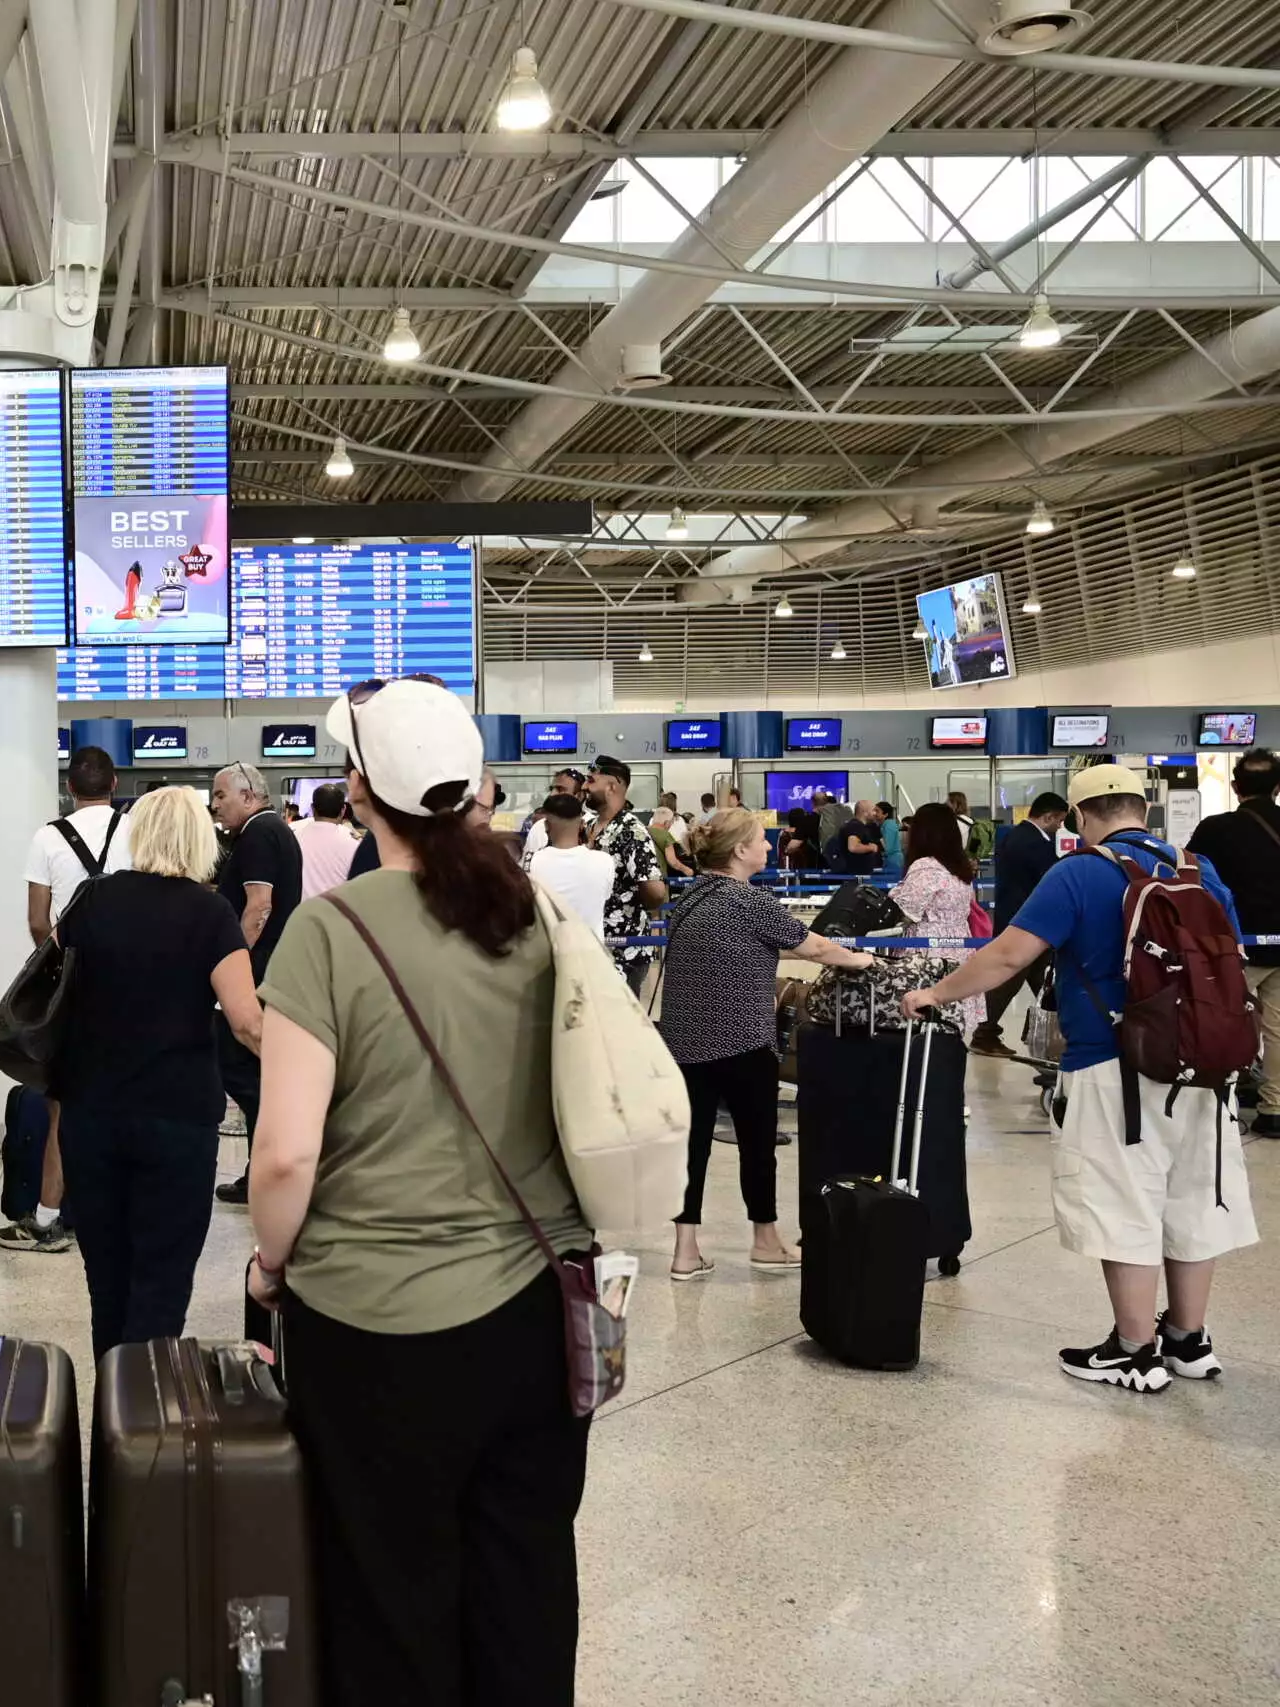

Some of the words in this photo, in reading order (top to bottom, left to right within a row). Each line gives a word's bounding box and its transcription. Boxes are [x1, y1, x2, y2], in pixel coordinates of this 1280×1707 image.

[111, 510, 189, 532] BEST
[111, 535, 187, 549] SELLERS
[184, 555, 208, 563] GREAT
[847, 738, 860, 750] 73
[907, 738, 920, 749] 72
[1112, 735, 1125, 747] 71
[1174, 734, 1188, 746] 70
[195, 747, 208, 759] 78
[324, 745, 337, 756] 77
[583, 742, 596, 754] 75
[645, 741, 657, 753] 74
